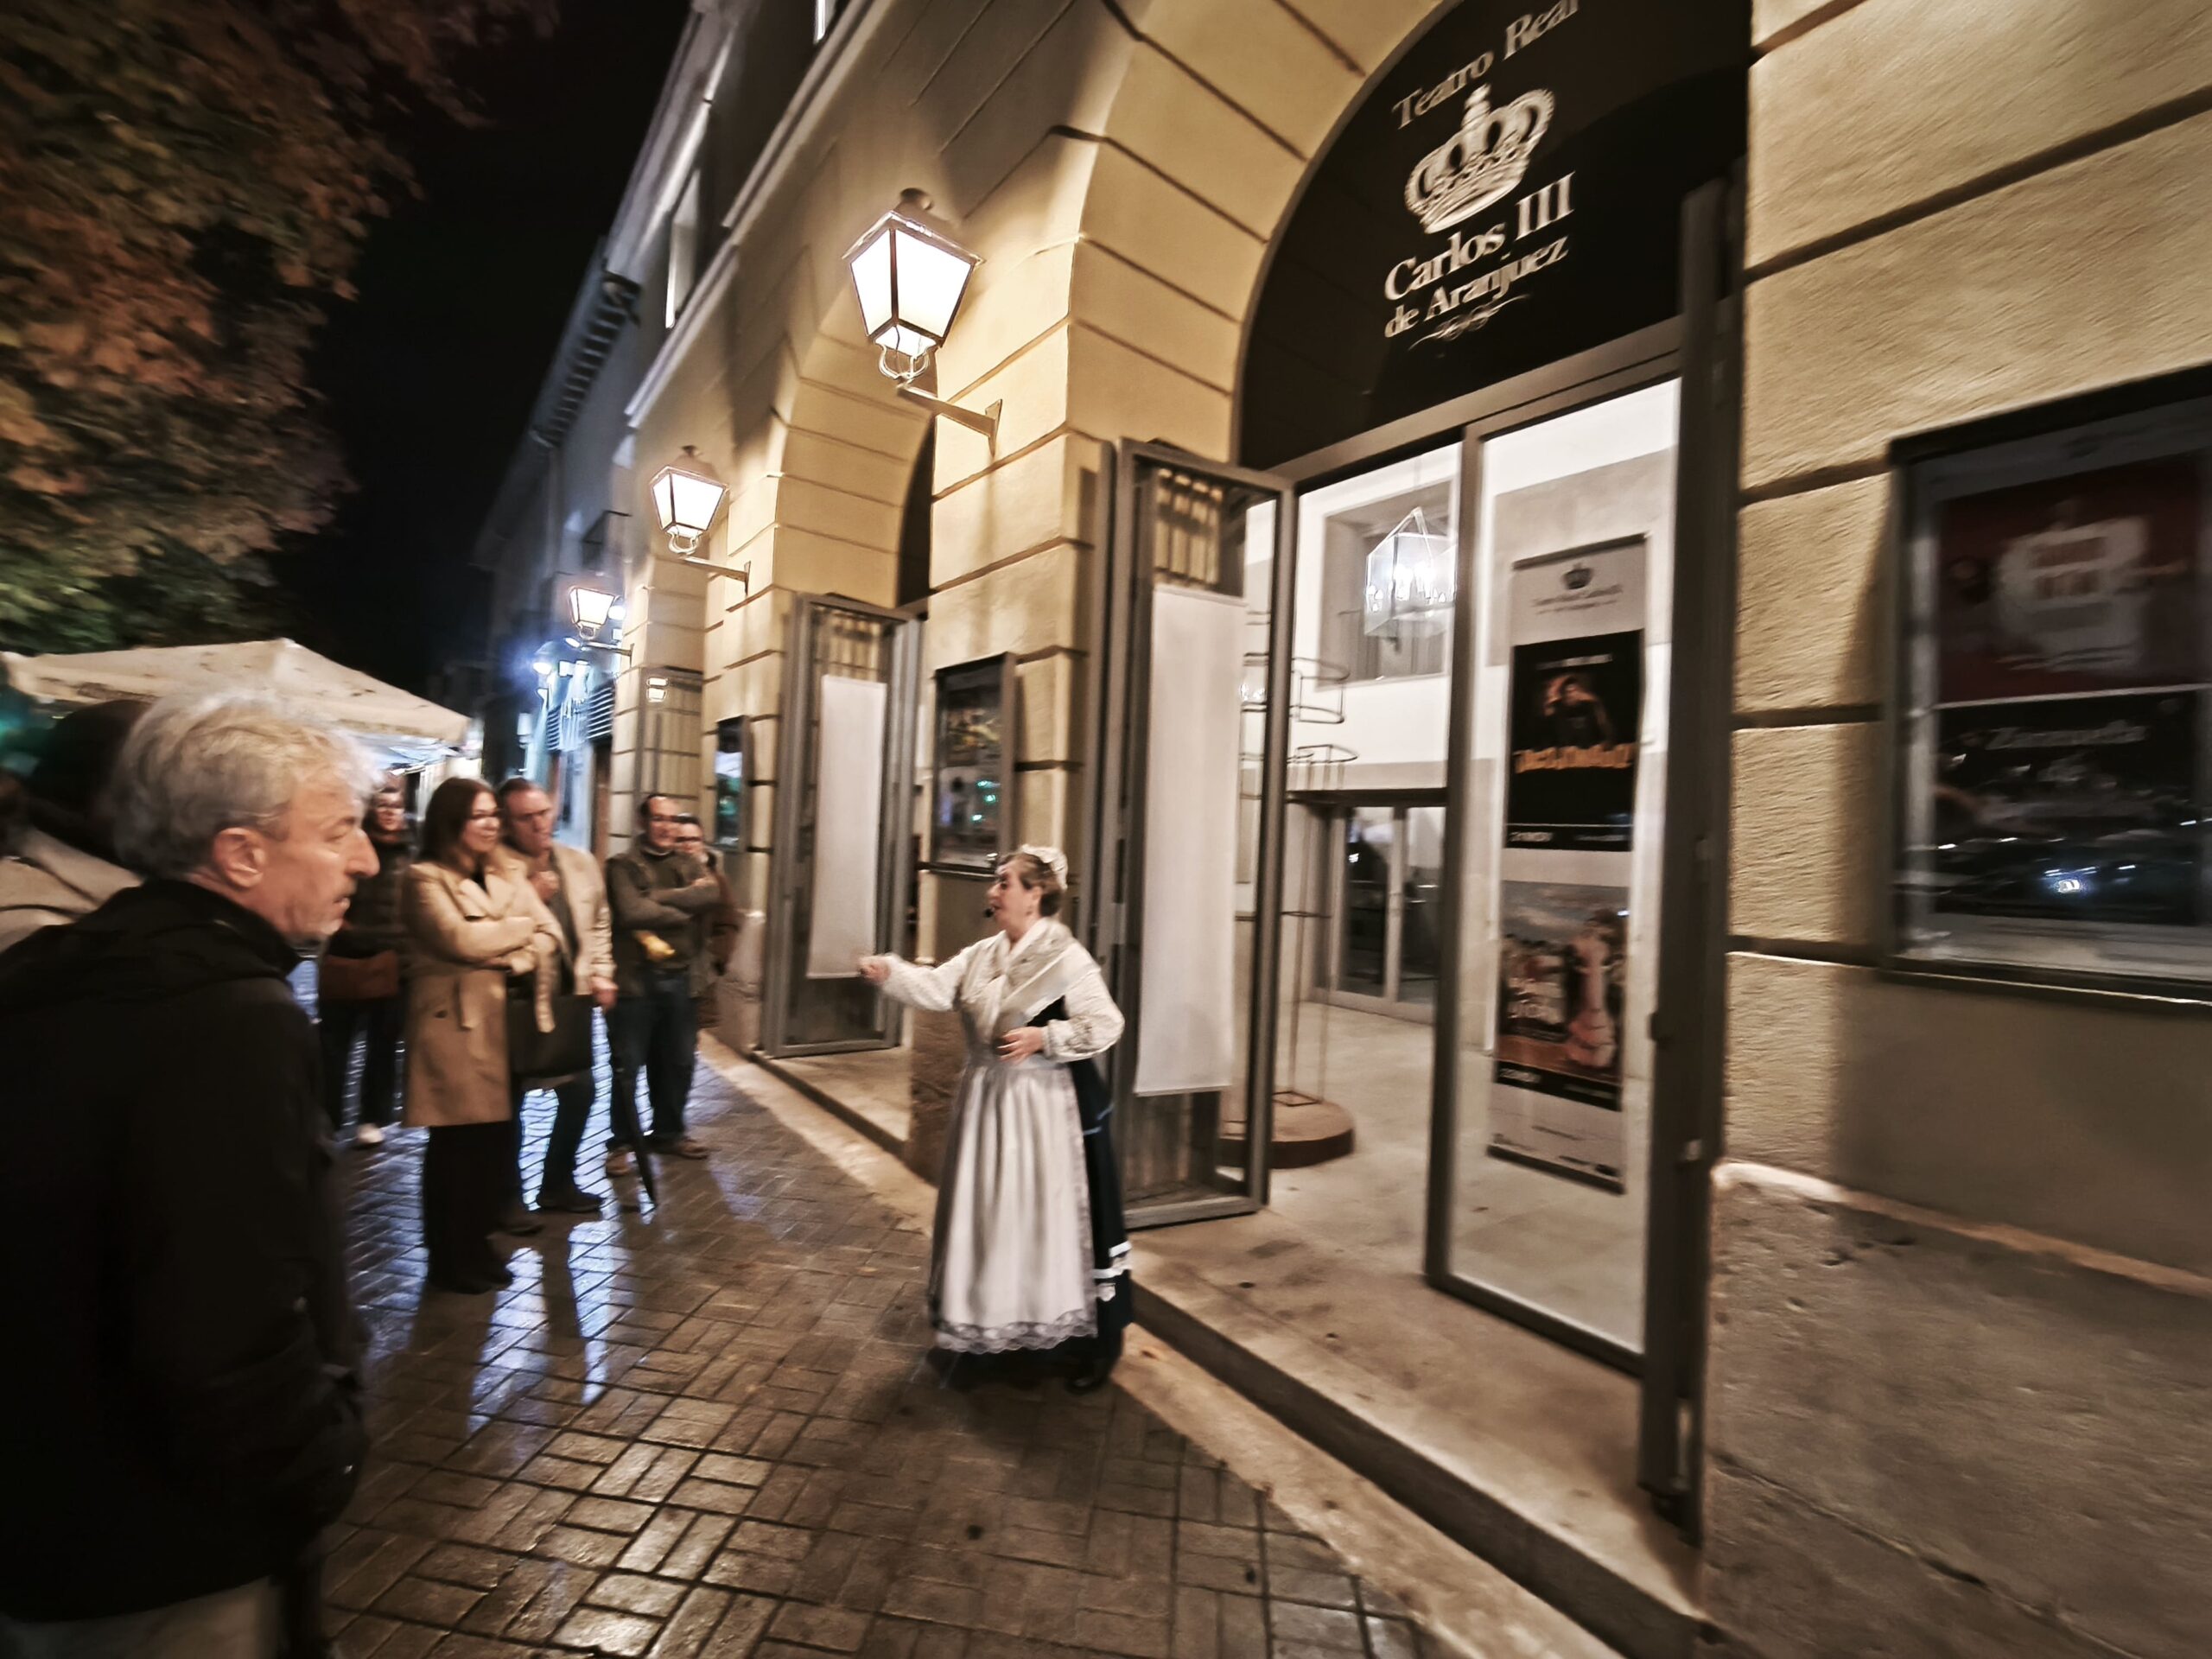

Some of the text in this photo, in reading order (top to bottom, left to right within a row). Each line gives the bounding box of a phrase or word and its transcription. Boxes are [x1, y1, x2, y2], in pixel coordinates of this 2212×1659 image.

[1392, 50, 1495, 130] Teatro
[1384, 170, 1576, 301] Carlos III
[1384, 235, 1569, 338] de Aranjuez
